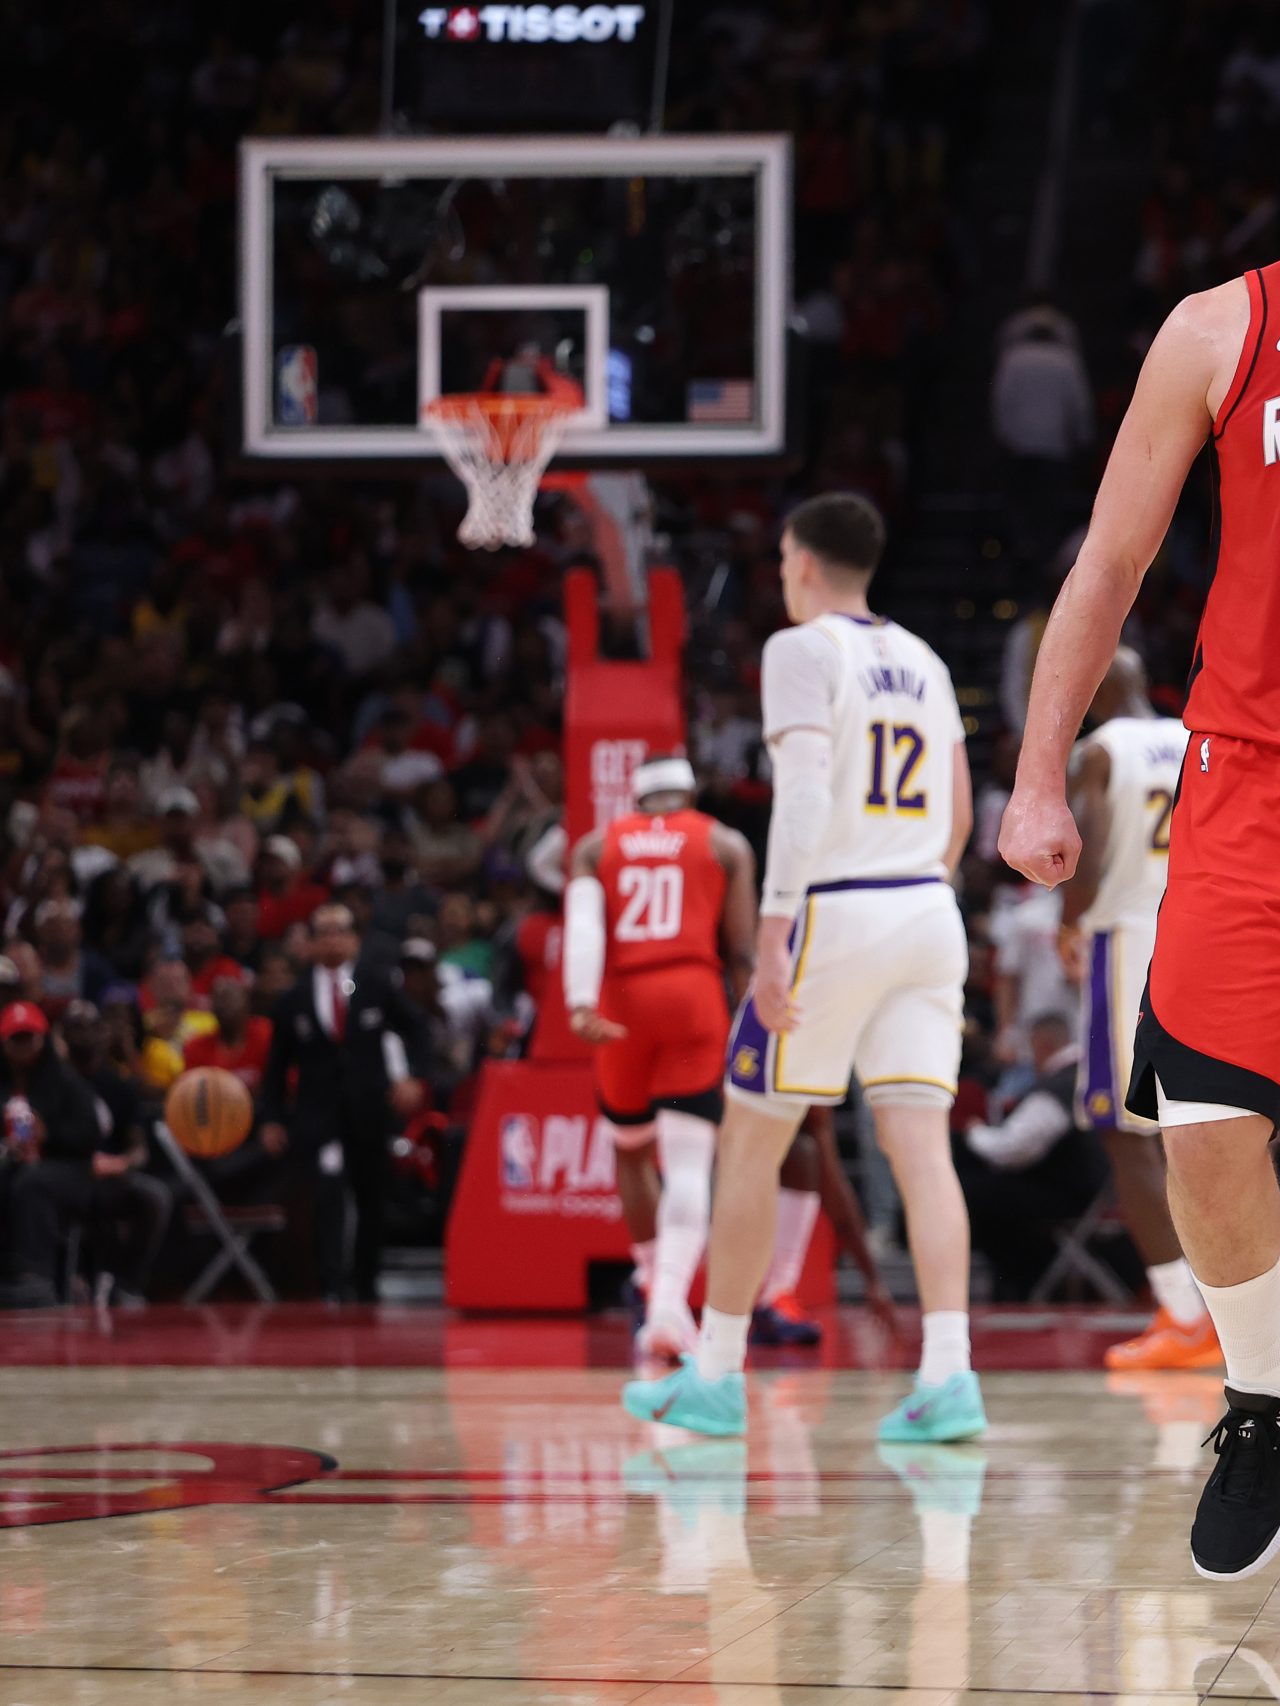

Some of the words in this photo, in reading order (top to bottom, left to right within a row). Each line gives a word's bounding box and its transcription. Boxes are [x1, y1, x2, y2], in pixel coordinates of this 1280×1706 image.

[480, 4, 645, 43] TISSOT
[863, 719, 928, 818] 12
[1148, 784, 1172, 856] 2
[615, 864, 684, 942] 20
[539, 1114, 617, 1190] PLA
